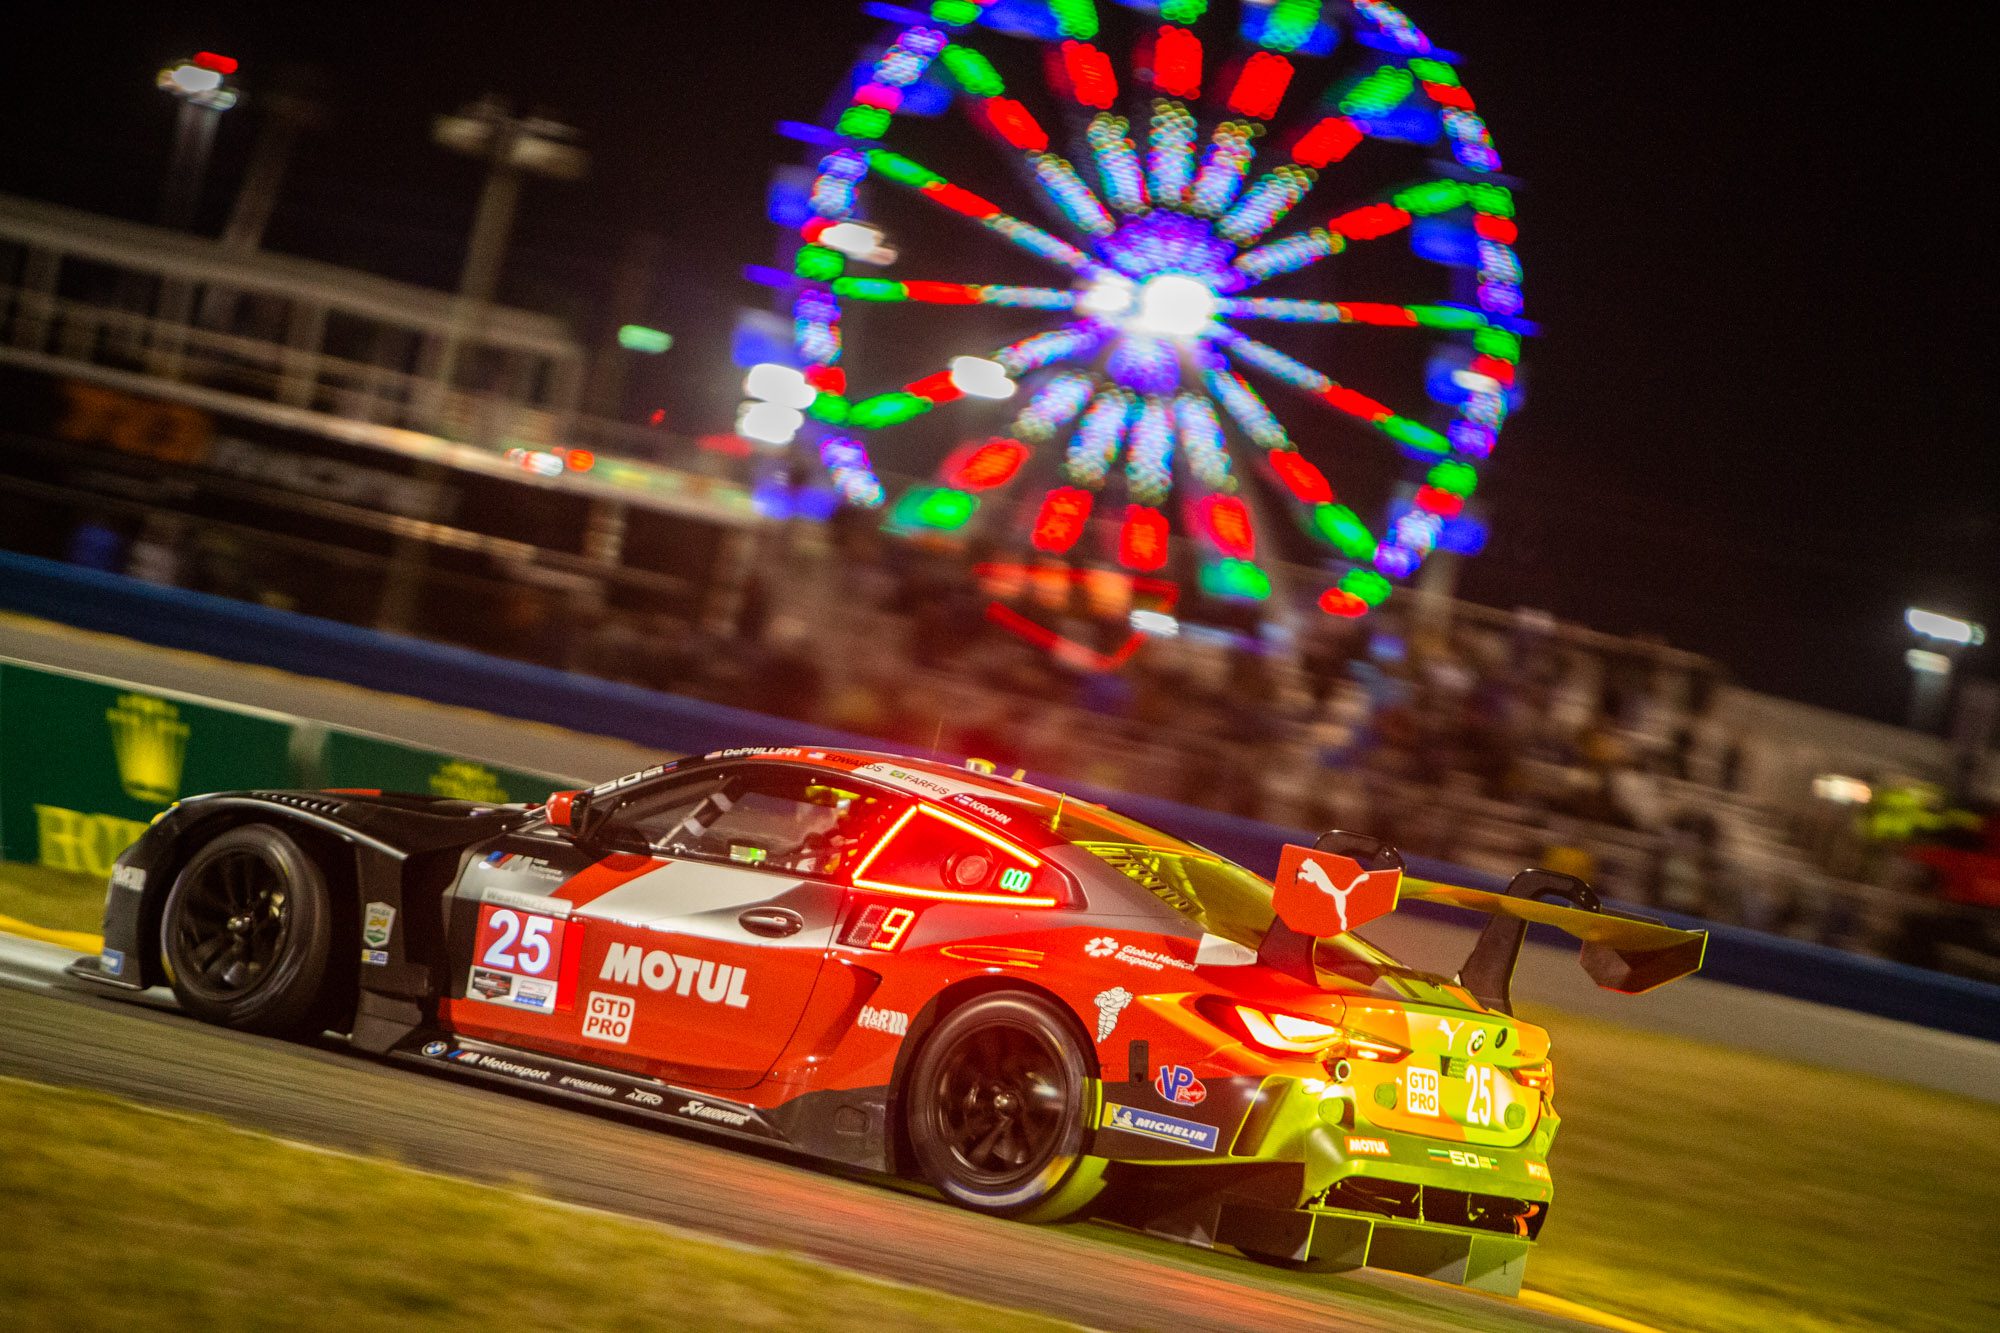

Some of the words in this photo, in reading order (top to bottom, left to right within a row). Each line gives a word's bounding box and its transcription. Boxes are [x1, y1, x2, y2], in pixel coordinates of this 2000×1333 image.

[824, 753, 884, 773] EDWARDS
[903, 774, 950, 796] FARFUS
[968, 800, 1012, 825] KROHN
[483, 909, 554, 974] 25
[1115, 951, 1164, 971] Response
[1122, 945, 1158, 960] Global
[1156, 953, 1198, 972] Medical
[599, 942, 750, 1009] MOTUL
[591, 996, 631, 1018] GTD
[586, 1016, 627, 1038] PRO
[479, 1055, 550, 1081] Motorsport
[1161, 1065, 1194, 1102] VP
[1409, 1071, 1437, 1092] GTD
[1409, 1091, 1437, 1111] PRO
[1466, 1064, 1491, 1126] 25
[1135, 1117, 1207, 1141] MICHELIN
[1350, 1138, 1389, 1153] MOTUL
